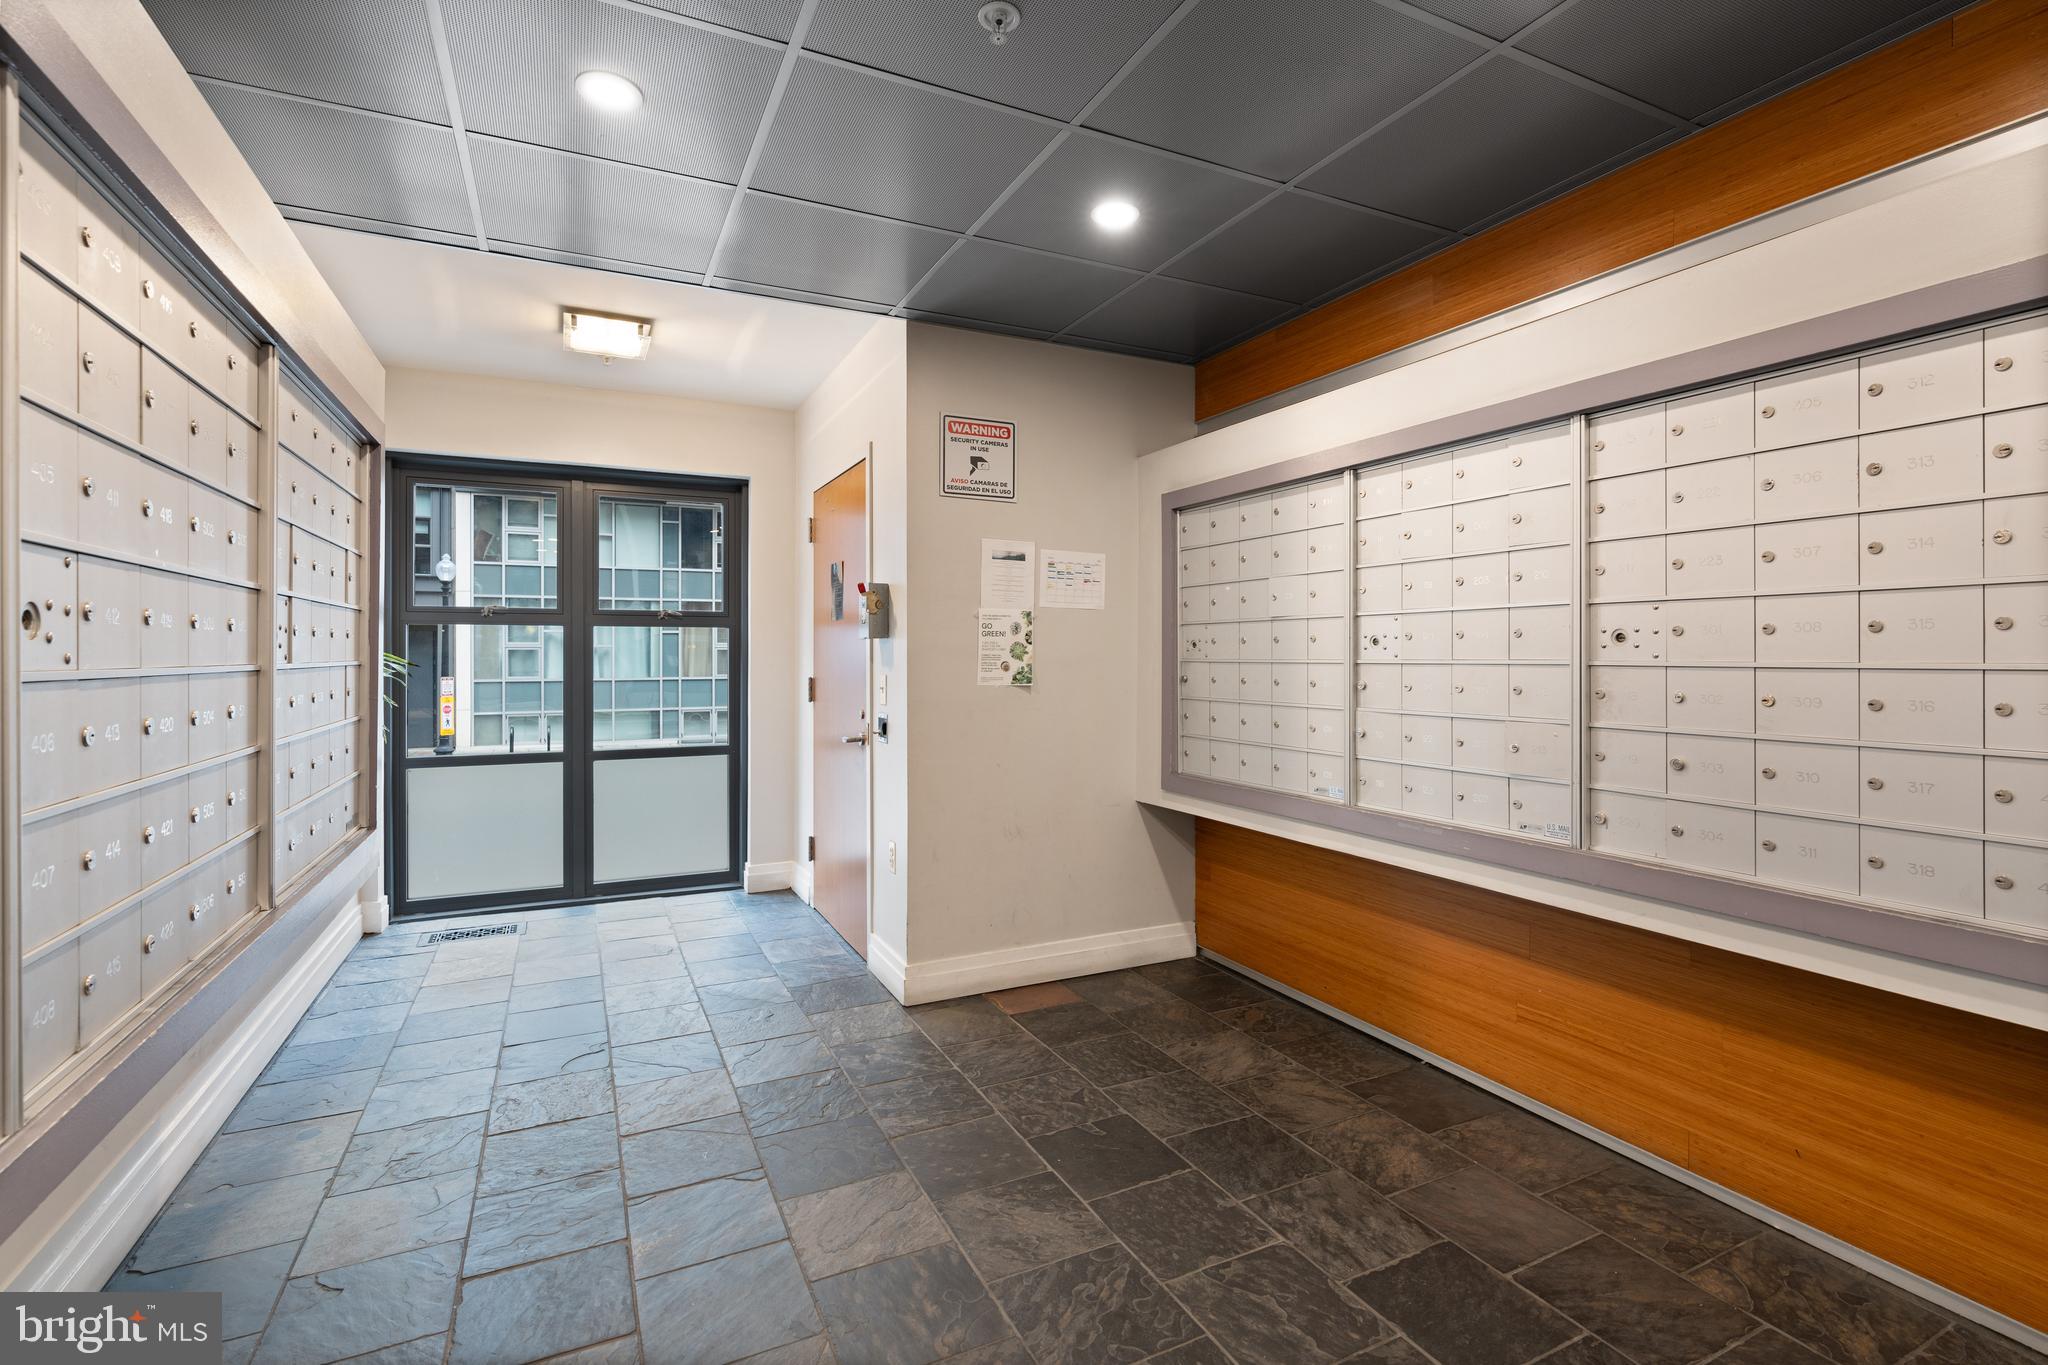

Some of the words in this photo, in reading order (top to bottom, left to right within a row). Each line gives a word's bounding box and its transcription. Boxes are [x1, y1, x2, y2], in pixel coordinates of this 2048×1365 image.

[1907, 374, 1936, 390] 312
[950, 422, 1009, 438] WARNING
[950, 436, 980, 444] SECURITY
[980, 440, 1009, 448] CAMERAS
[1907, 455, 1936, 470] 313
[1907, 537, 1936, 550] 314
[1907, 618, 1936, 632] 315
[1907, 700, 1936, 713] 316
[160, 716, 174, 734] 420
[1907, 781, 1936, 796] 317
[160, 818, 174, 837] 421
[105, 839, 121, 860] 414
[1800, 846, 1817, 858] 311
[32, 865, 56, 890] 407
[1907, 862, 1936, 878] 318
